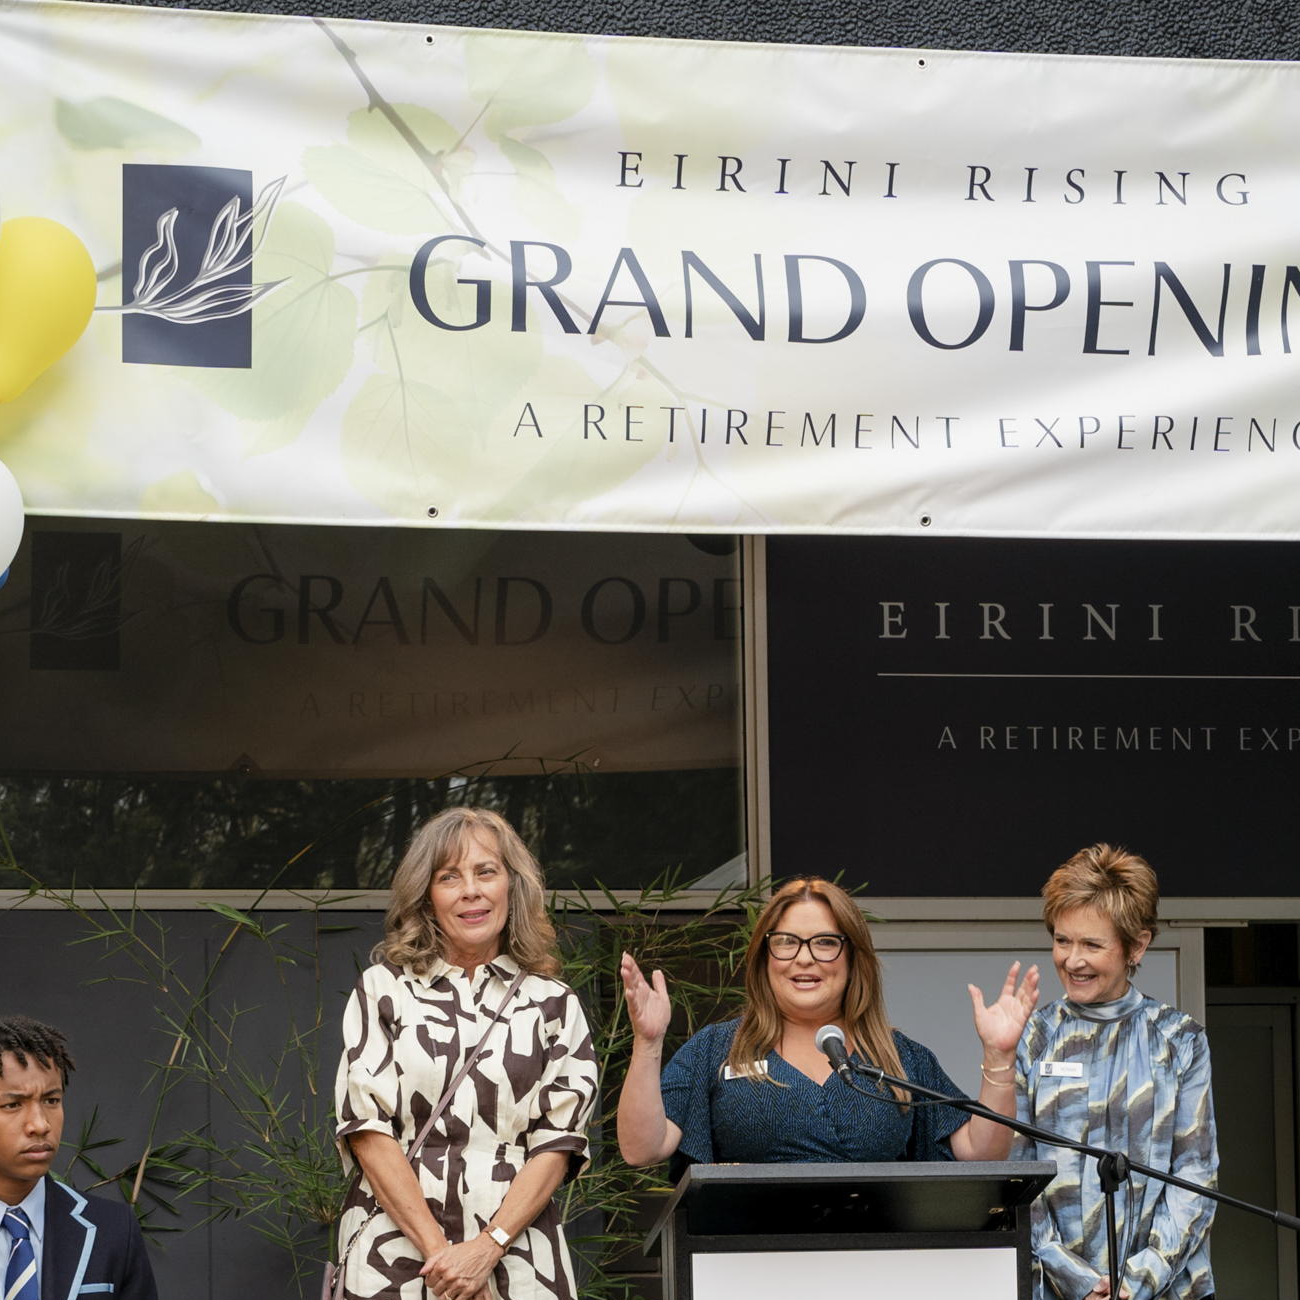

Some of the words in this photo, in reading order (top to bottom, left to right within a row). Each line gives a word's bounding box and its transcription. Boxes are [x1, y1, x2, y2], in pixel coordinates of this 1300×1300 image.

[617, 151, 902, 198] EIRINI
[964, 164, 1250, 206] RISING
[408, 234, 868, 345] GRAND
[513, 402, 543, 438] A
[582, 404, 961, 450] RETIREMENT
[226, 573, 554, 646] GRAND
[877, 601, 1165, 642] EIRINI
[937, 726, 957, 750] A
[980, 726, 1218, 751] RETIREMENT
